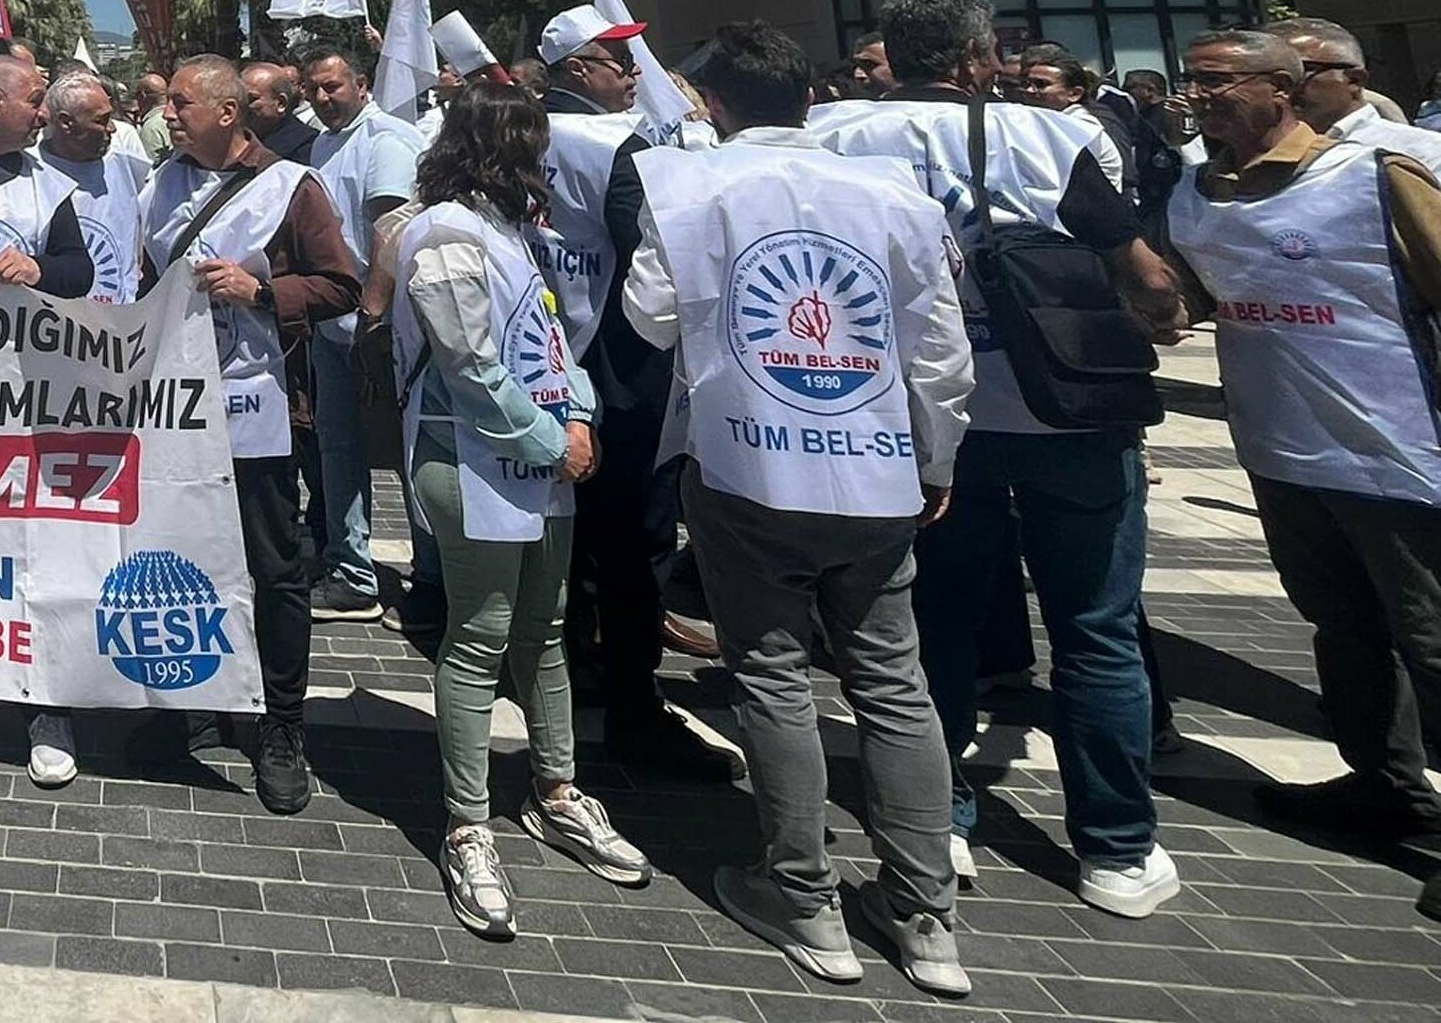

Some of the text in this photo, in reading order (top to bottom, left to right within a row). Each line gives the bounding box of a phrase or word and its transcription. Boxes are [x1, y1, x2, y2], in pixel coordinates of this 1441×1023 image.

[1232, 301, 1336, 325] BEL-SEN
[759, 350, 880, 372] TÜM BEL-SEN
[802, 375, 841, 390] 1990
[531, 388, 560, 403] TÜM
[725, 415, 914, 458] TÜM BEL-SE
[95, 607, 235, 656] KESK
[144, 659, 195, 685] 1995
